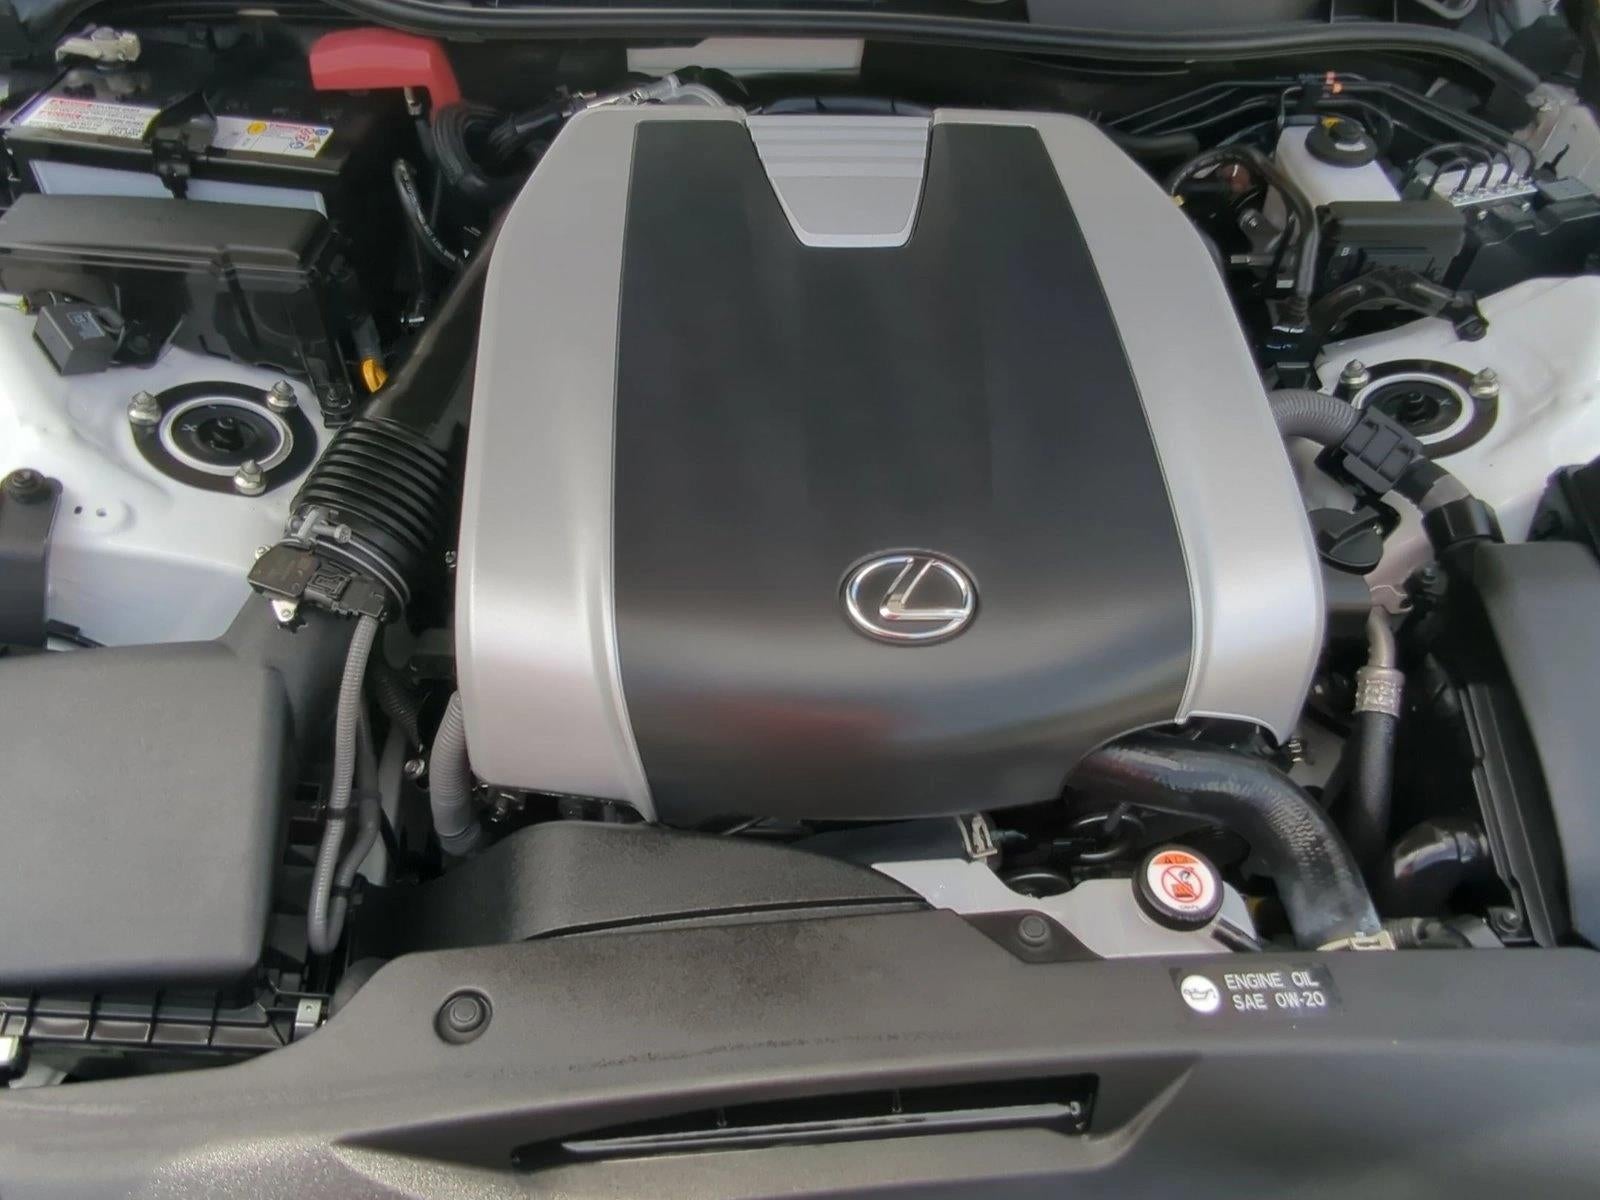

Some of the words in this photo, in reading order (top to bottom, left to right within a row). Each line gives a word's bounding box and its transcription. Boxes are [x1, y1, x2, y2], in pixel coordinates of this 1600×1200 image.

[1224, 972, 1284, 990] ENGINE
[1291, 971, 1320, 988] OIL
[1232, 993, 1268, 1011] SAE
[1274, 990, 1326, 1009] 0W-20
